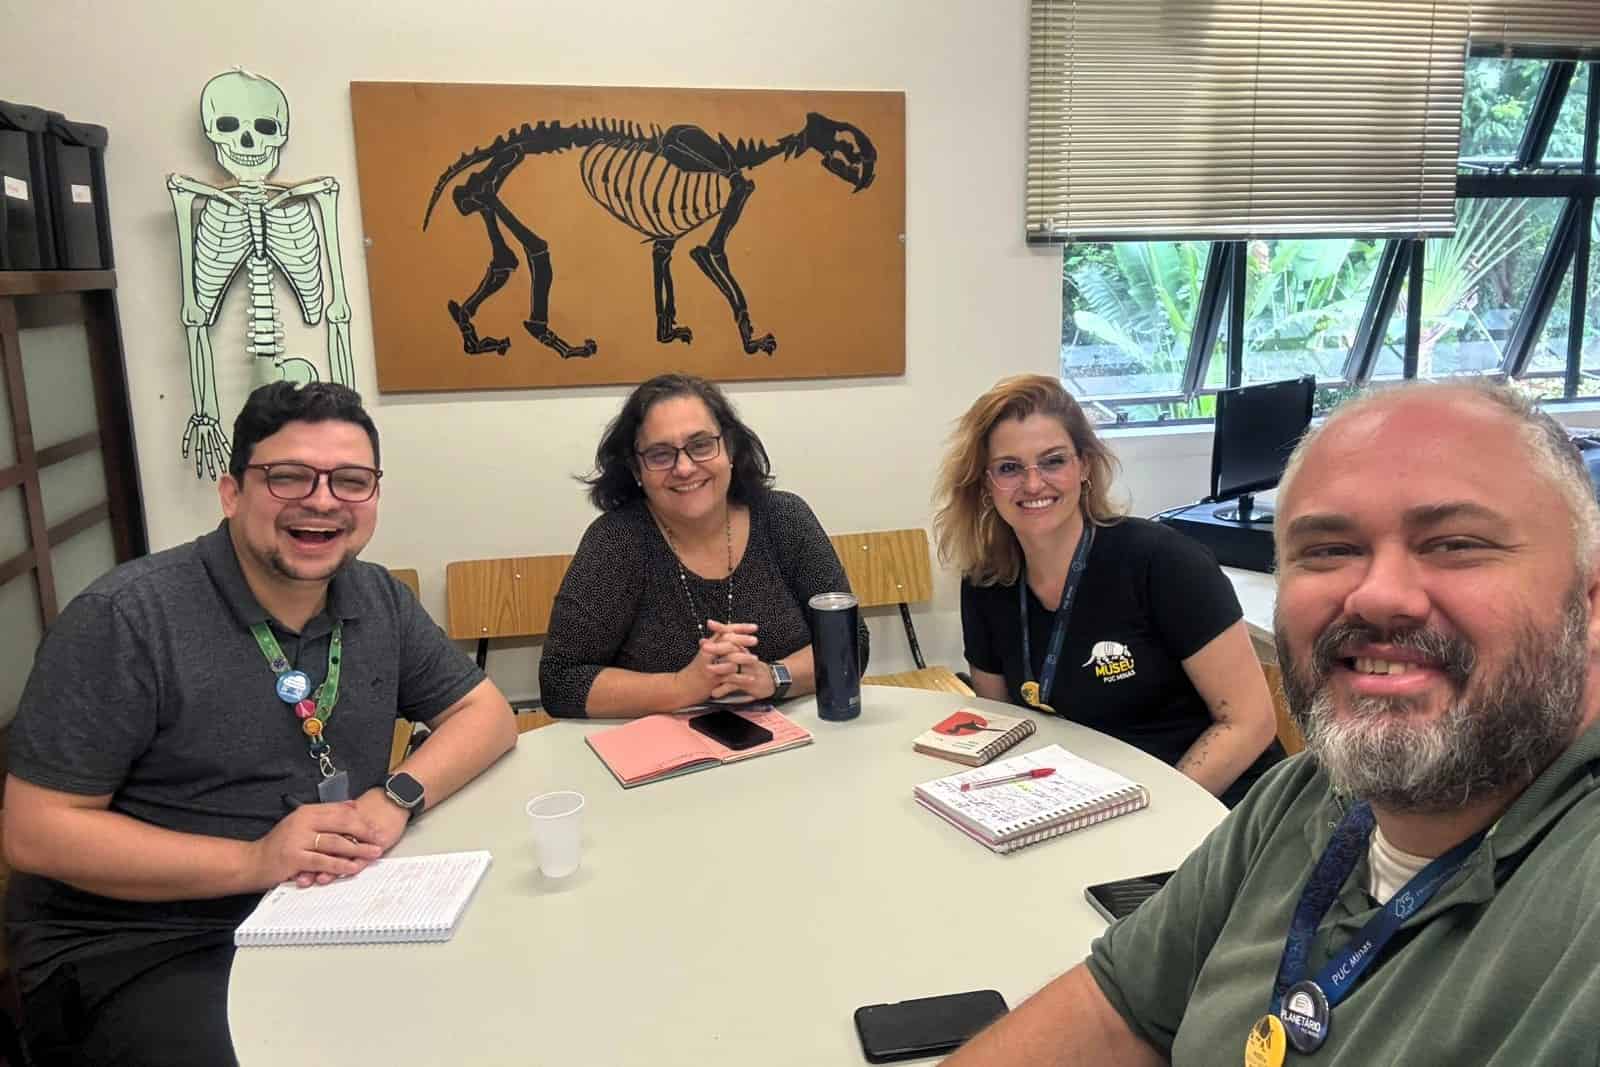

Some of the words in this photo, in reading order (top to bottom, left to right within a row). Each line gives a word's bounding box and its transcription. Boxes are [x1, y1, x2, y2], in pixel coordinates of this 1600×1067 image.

[1095, 658, 1135, 678] MUSEU
[1331, 962, 1351, 985] PUC
[1350, 940, 1372, 968] Minas
